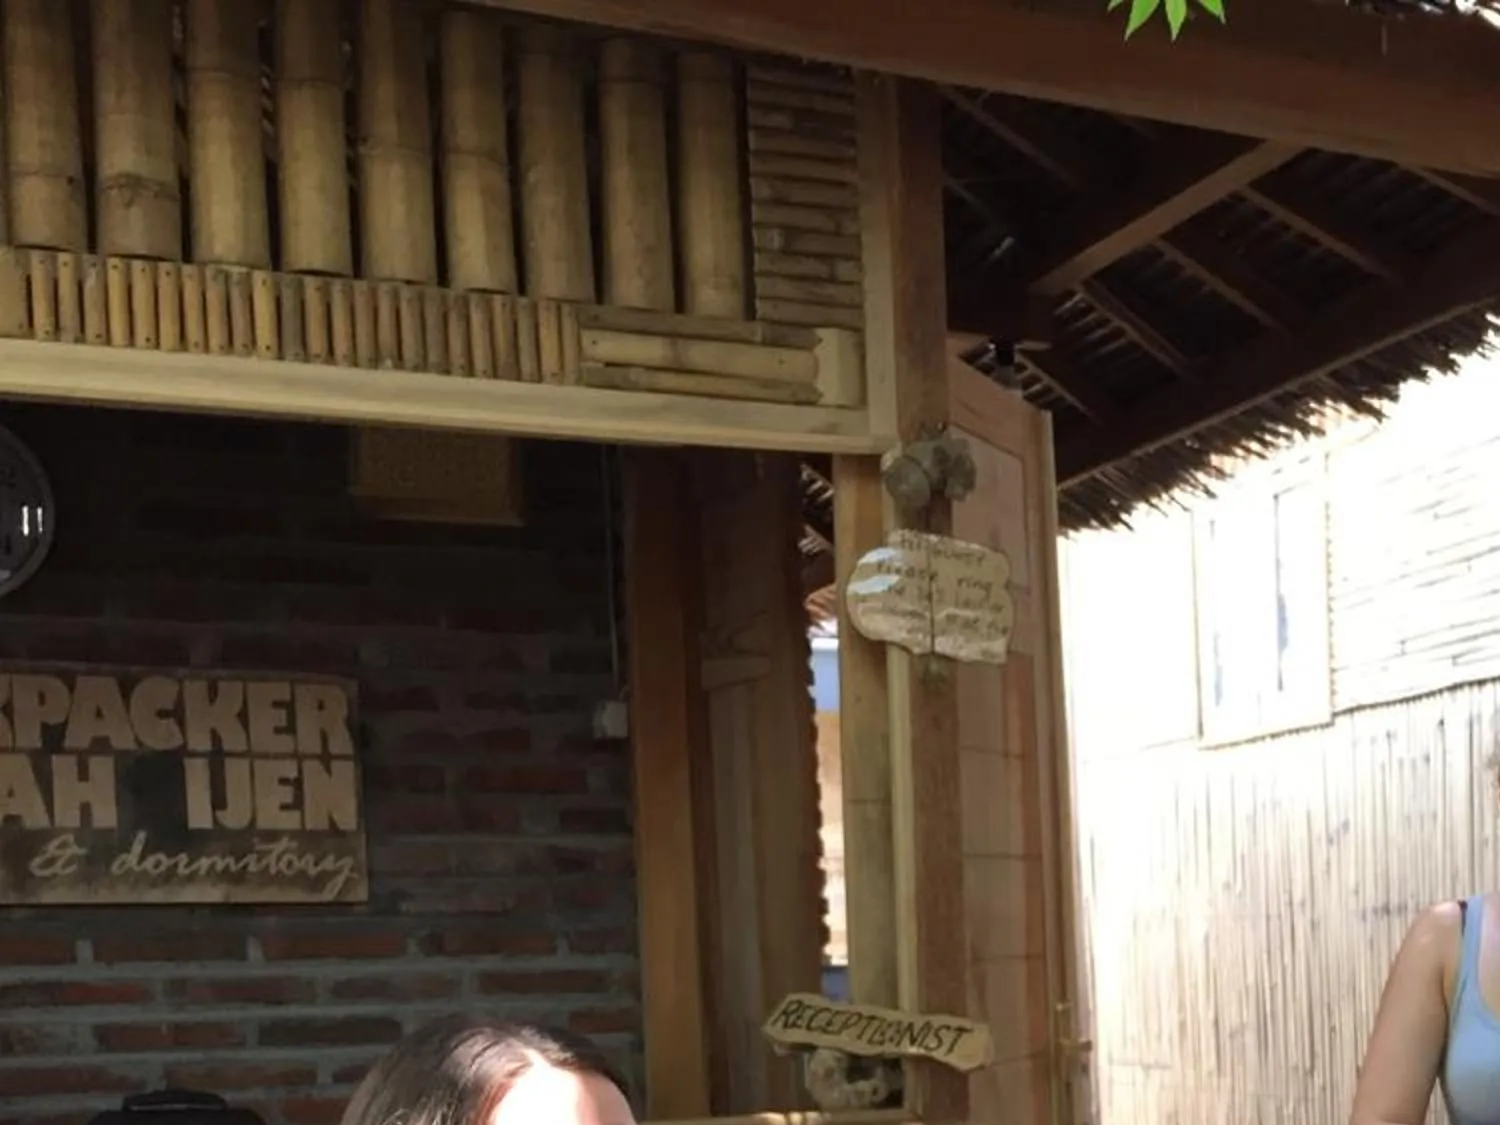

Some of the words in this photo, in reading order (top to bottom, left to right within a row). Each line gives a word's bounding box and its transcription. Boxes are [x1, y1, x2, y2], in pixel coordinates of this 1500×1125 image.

[0, 673, 354, 755] PACKER
[184, 757, 358, 831] IJEN
[111, 830, 358, 900] dormitory
